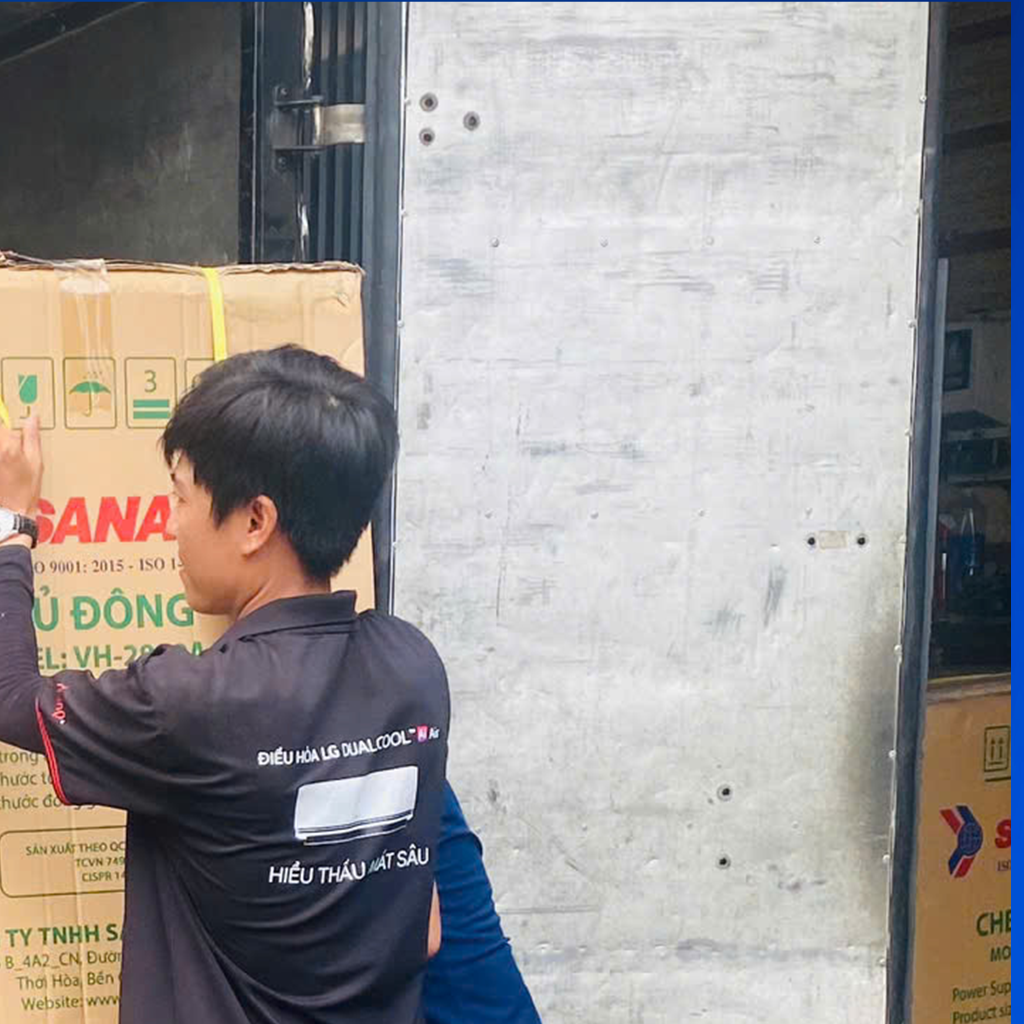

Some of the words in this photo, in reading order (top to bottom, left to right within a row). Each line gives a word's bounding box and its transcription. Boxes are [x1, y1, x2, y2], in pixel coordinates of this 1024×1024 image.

[49, 561, 88, 573] 9001:
[91, 559, 125, 573] 2015
[139, 558, 166, 571] ISO
[33, 585, 59, 631] Ủ
[70, 587, 194, 630] ĐÔNG
[320, 744, 341, 761] LG
[78, 842, 108, 853] THEO
[396, 843, 430, 868] SÂU
[76, 858, 104, 868] TCVN
[81, 872, 112, 882] CISPR
[5, 927, 33, 948] TY
[38, 925, 100, 945] TNHH
[952, 986, 988, 1002] Power
[21, 996, 83, 1011] Website:
[952, 1006, 997, 1024] Product
